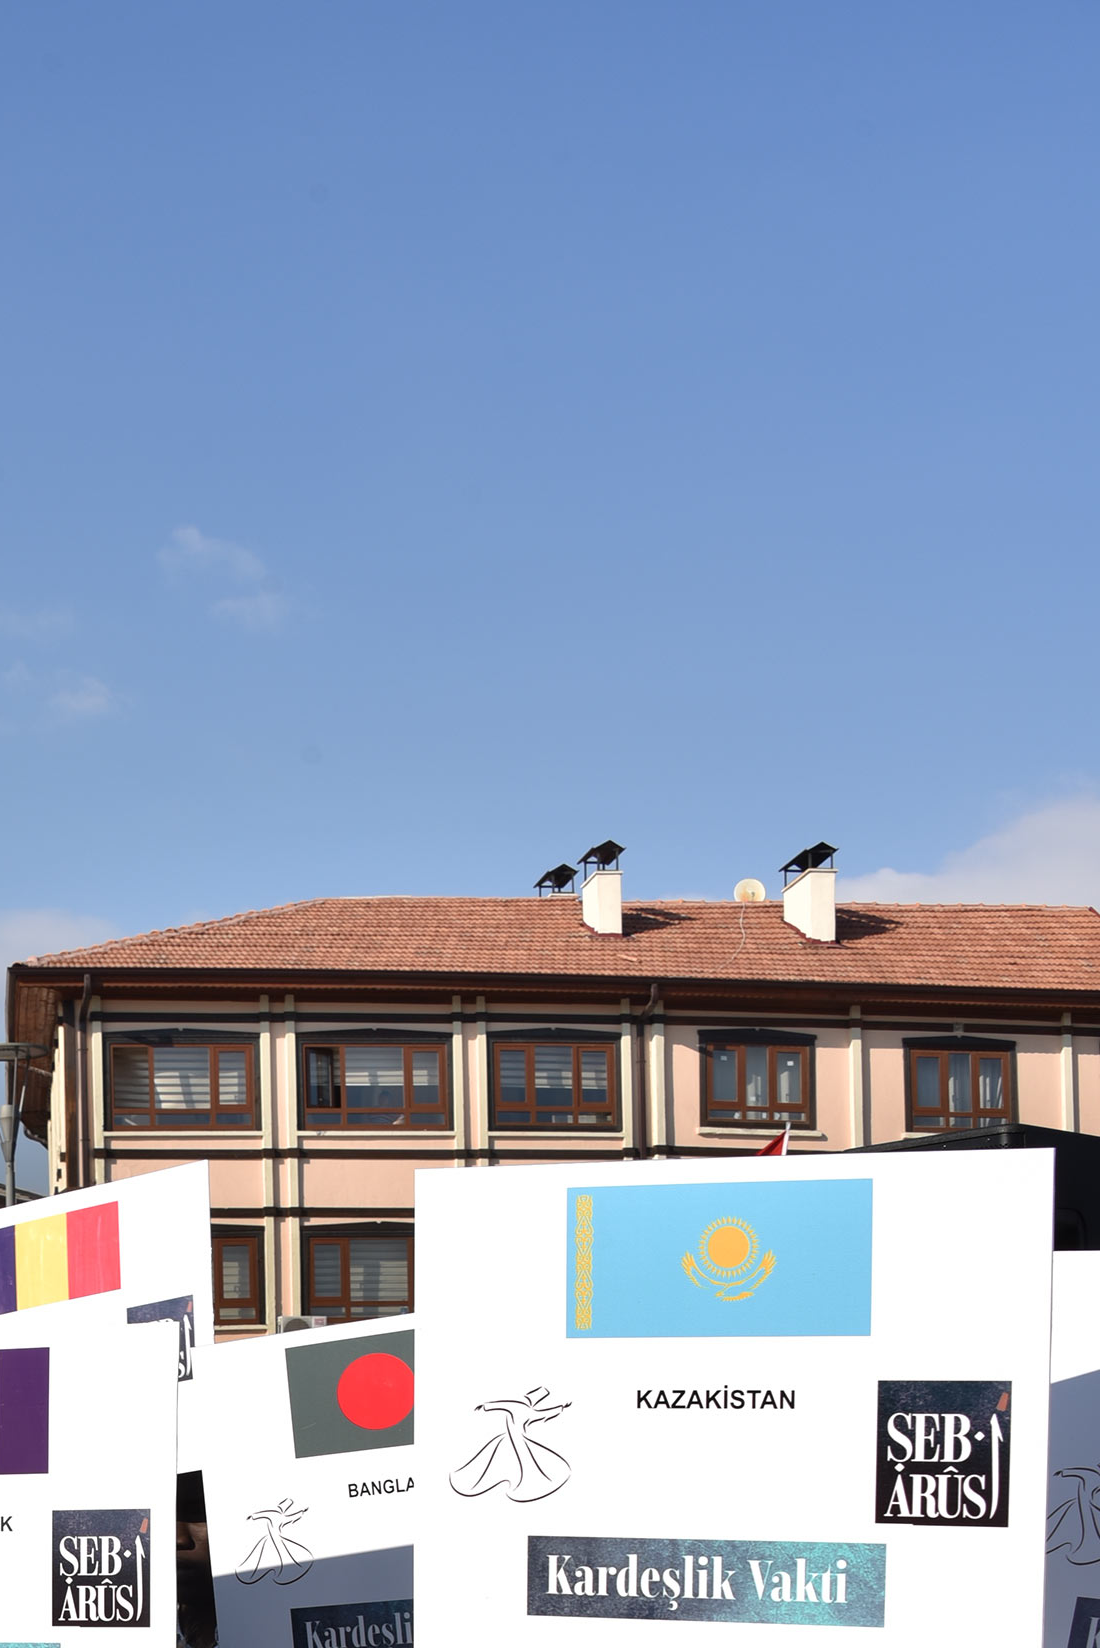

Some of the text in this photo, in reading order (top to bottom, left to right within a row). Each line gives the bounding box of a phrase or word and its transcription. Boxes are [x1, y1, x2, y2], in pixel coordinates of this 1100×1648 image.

[636, 1386, 796, 1410] KAZAKİSTAN
[545, 1553, 849, 1610] Kardeşlik Vakti
